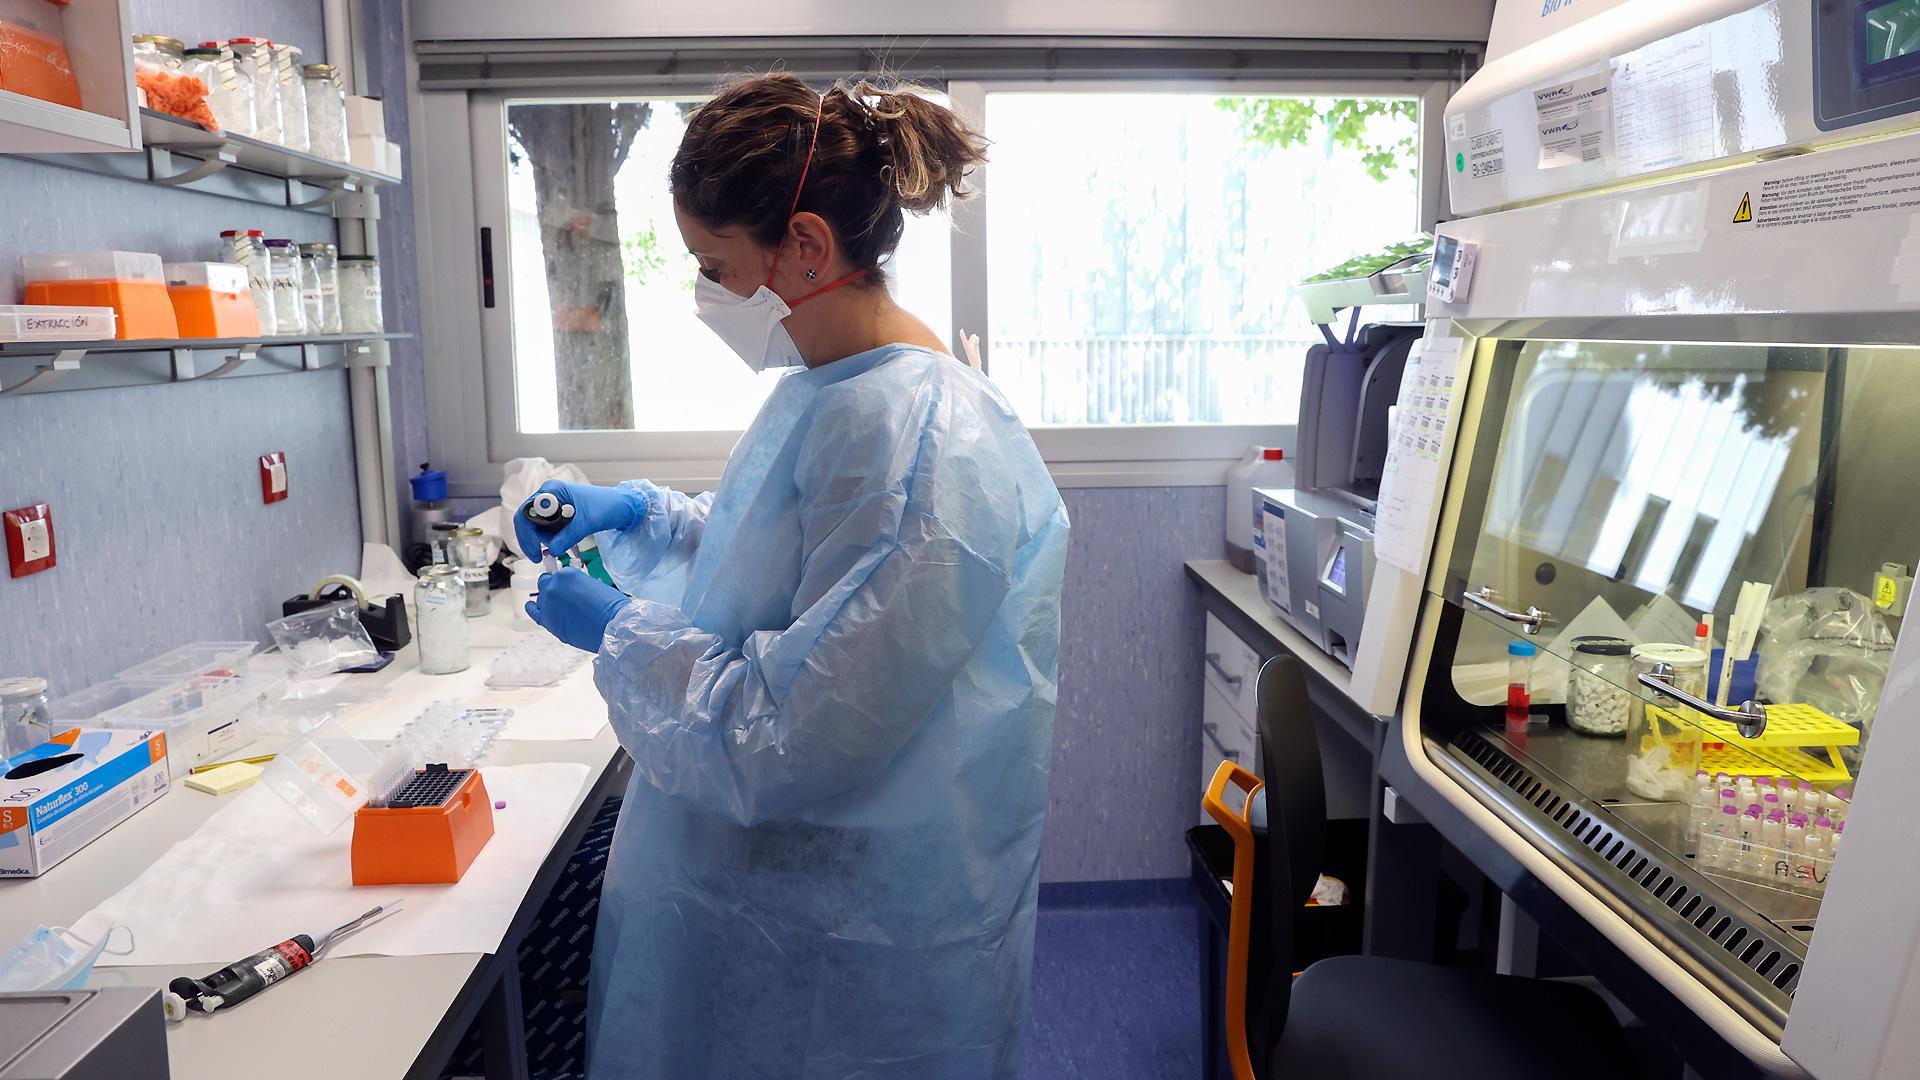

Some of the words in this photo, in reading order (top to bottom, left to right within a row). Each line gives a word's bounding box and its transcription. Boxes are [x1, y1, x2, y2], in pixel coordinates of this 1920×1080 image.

[1538, 90, 1558, 100] VWR
[1542, 126, 1562, 136] VWR
[27, 316, 88, 330] EXTRACCIÓN
[4, 787, 40, 802] 100
[74, 782, 88, 796] 300
[2, 810, 12, 822] S
[558, 880, 580, 902] QIAGEN
[578, 896, 598, 918] QIAGEN
[568, 924, 589, 945] QIAGEN
[560, 951, 580, 970] QIAGEN
